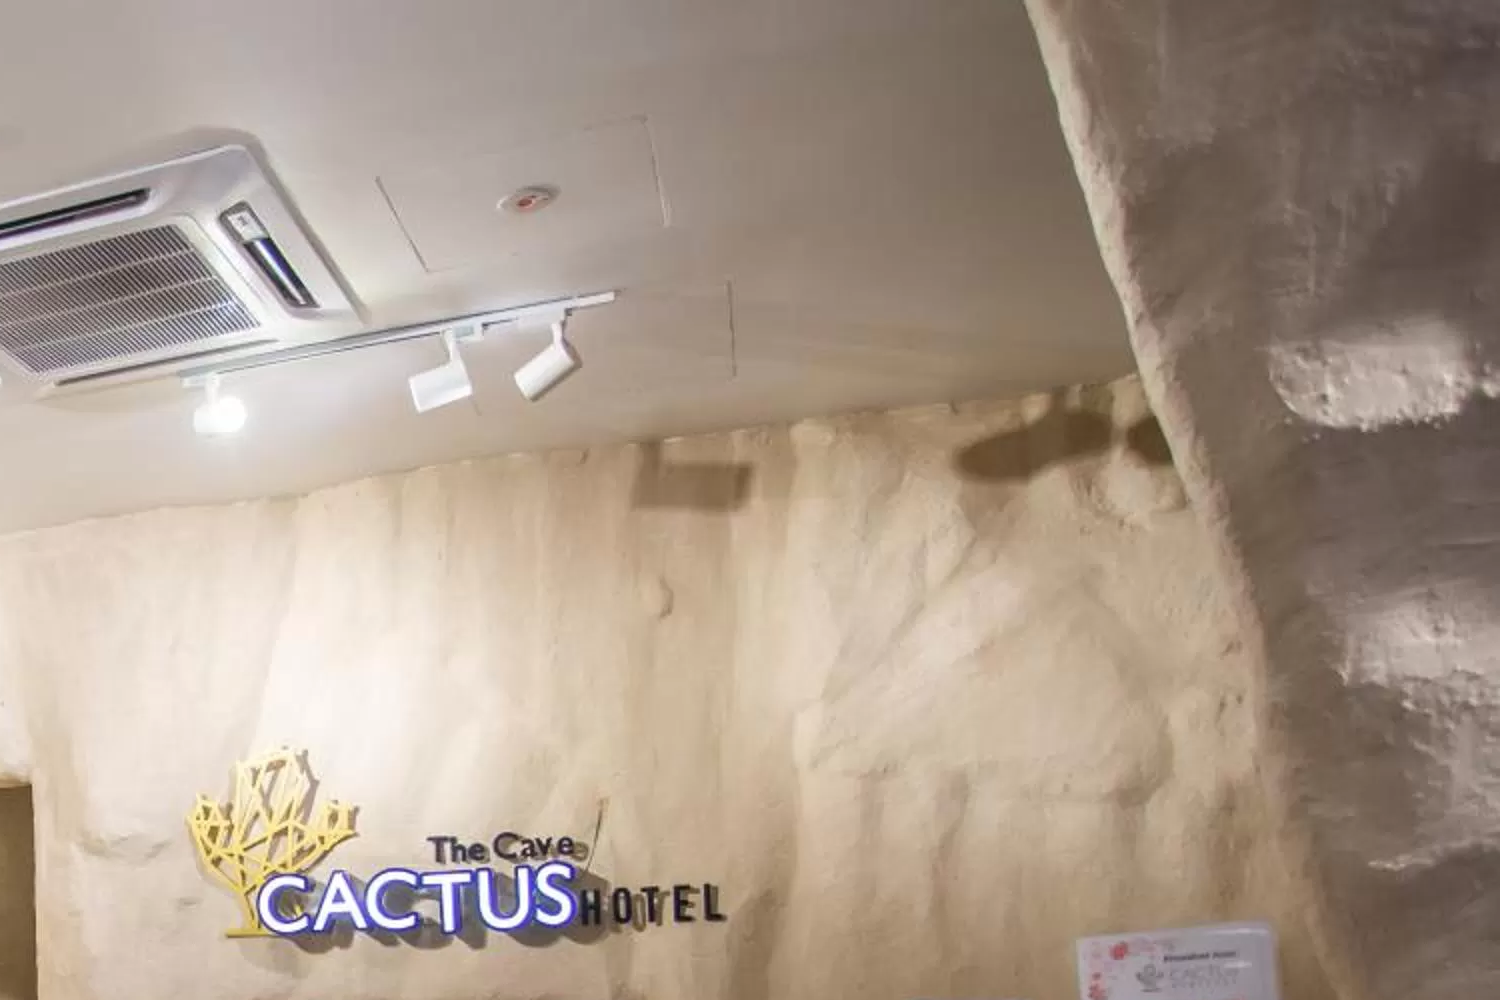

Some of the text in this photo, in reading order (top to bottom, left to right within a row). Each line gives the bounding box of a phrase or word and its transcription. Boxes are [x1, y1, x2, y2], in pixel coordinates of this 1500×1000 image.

[426, 831, 575, 864] The Cave
[256, 859, 728, 937] CACTUS HOTEL
